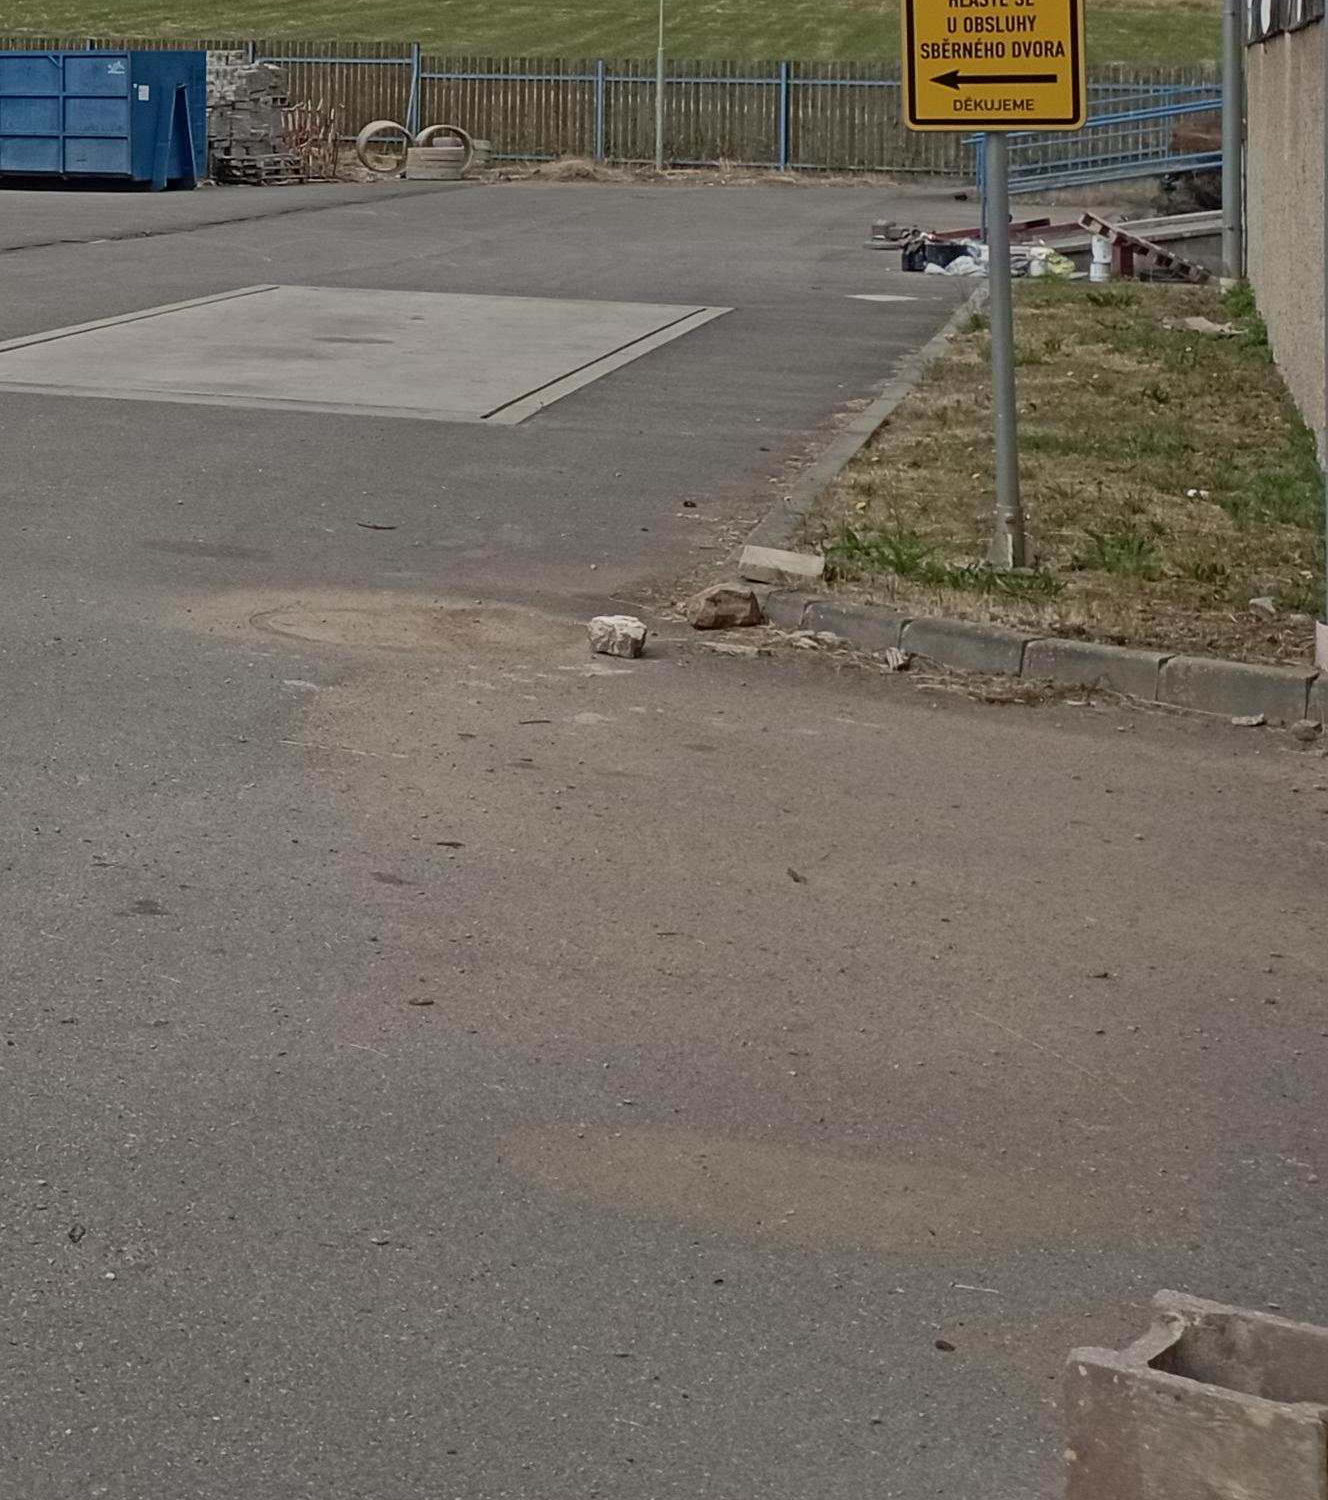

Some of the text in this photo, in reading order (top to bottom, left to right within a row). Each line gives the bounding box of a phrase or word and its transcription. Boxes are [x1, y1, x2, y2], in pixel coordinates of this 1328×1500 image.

[947, 15, 1037, 33] U OBSLUHY
[920, 38, 1065, 60] SBĚRNÉHO DVORA
[953, 96, 1035, 112] DĚKUJEME
